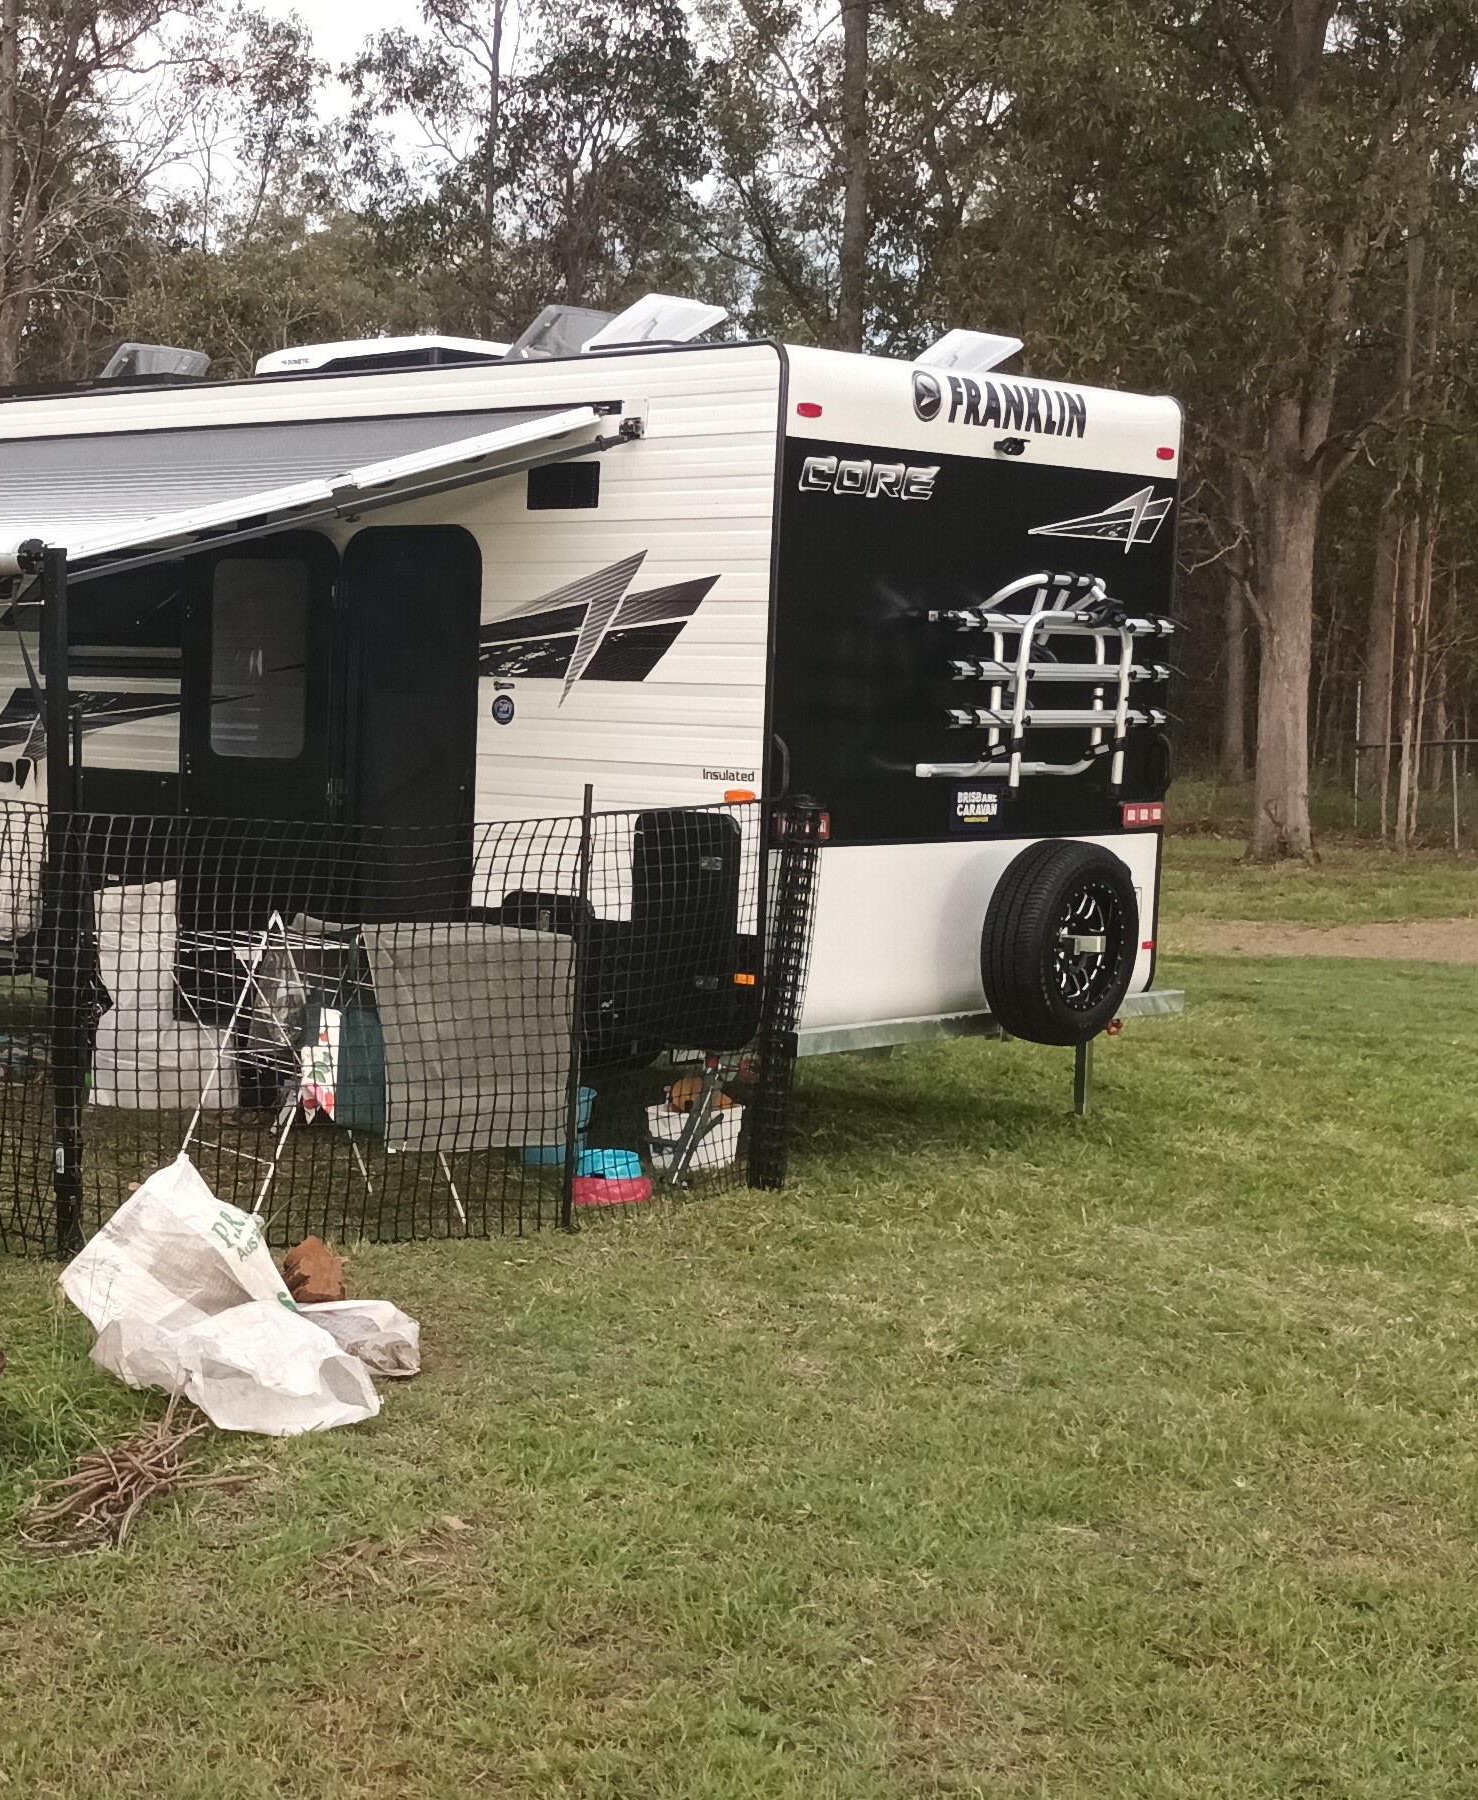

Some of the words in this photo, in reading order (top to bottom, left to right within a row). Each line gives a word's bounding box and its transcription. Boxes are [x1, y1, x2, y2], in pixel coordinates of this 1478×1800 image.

[946, 375, 1087, 439] FRANKLIN
[798, 455, 942, 501] CORE
[702, 768, 755, 782] Insulated
[957, 791, 998, 804] BRISBANE
[956, 803, 998, 817] CARAVAN
